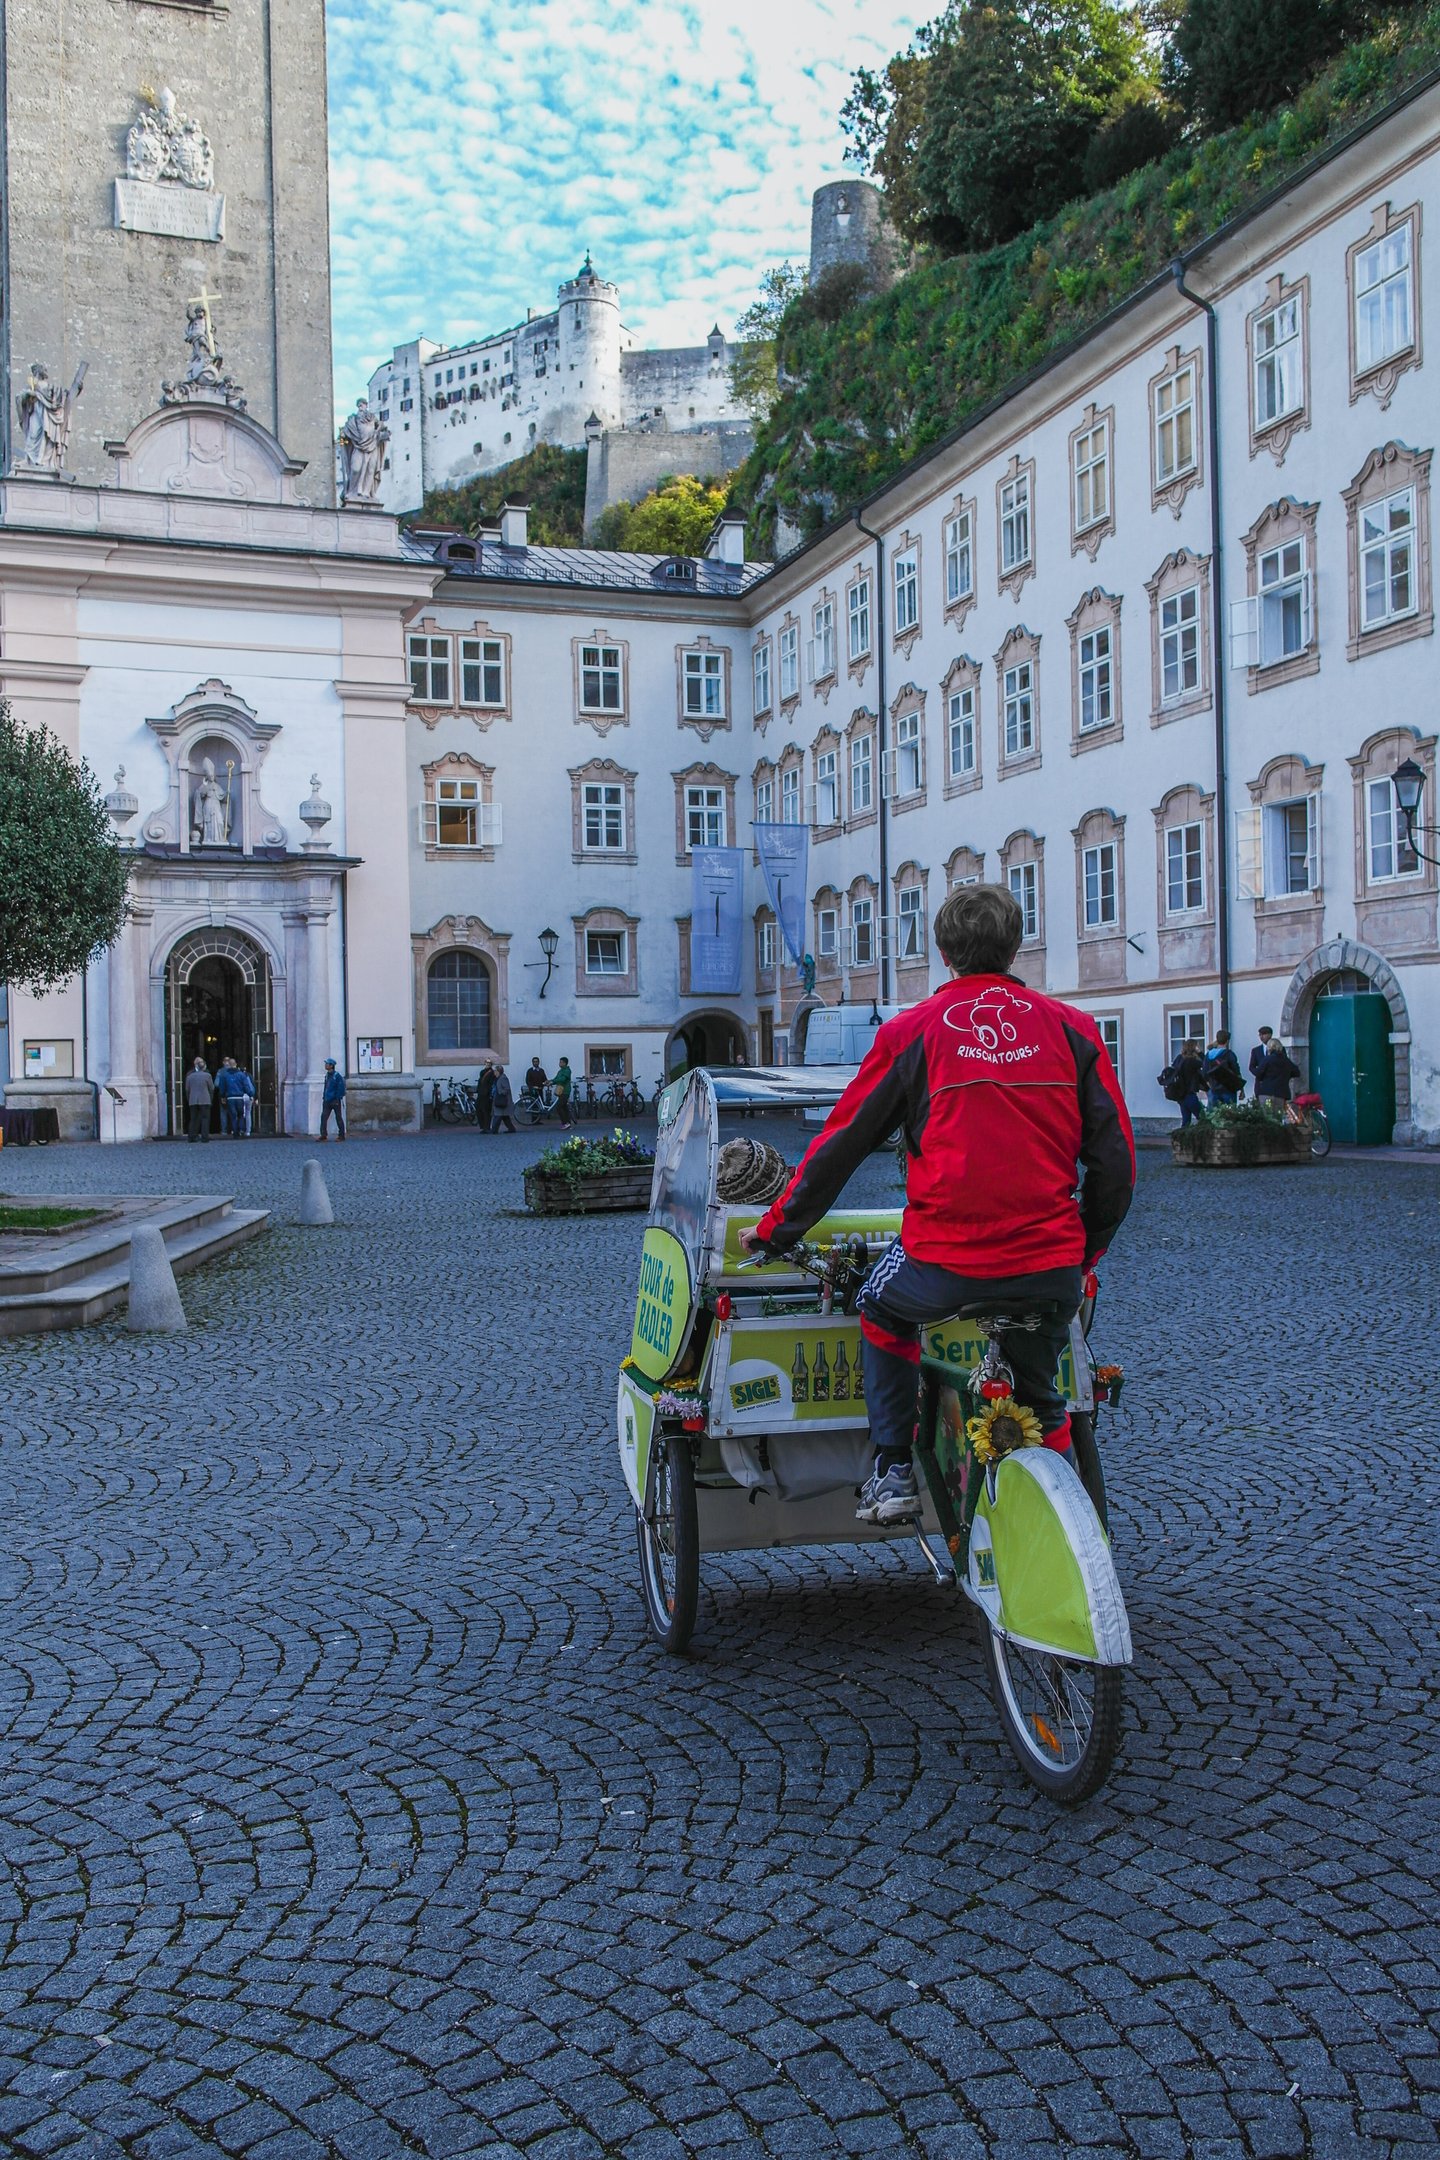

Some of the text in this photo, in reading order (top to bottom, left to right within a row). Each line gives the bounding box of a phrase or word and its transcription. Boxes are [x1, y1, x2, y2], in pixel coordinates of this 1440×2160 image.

[640, 1252, 674, 1308] TOUR de
[637, 1298, 673, 1358] RADLER
